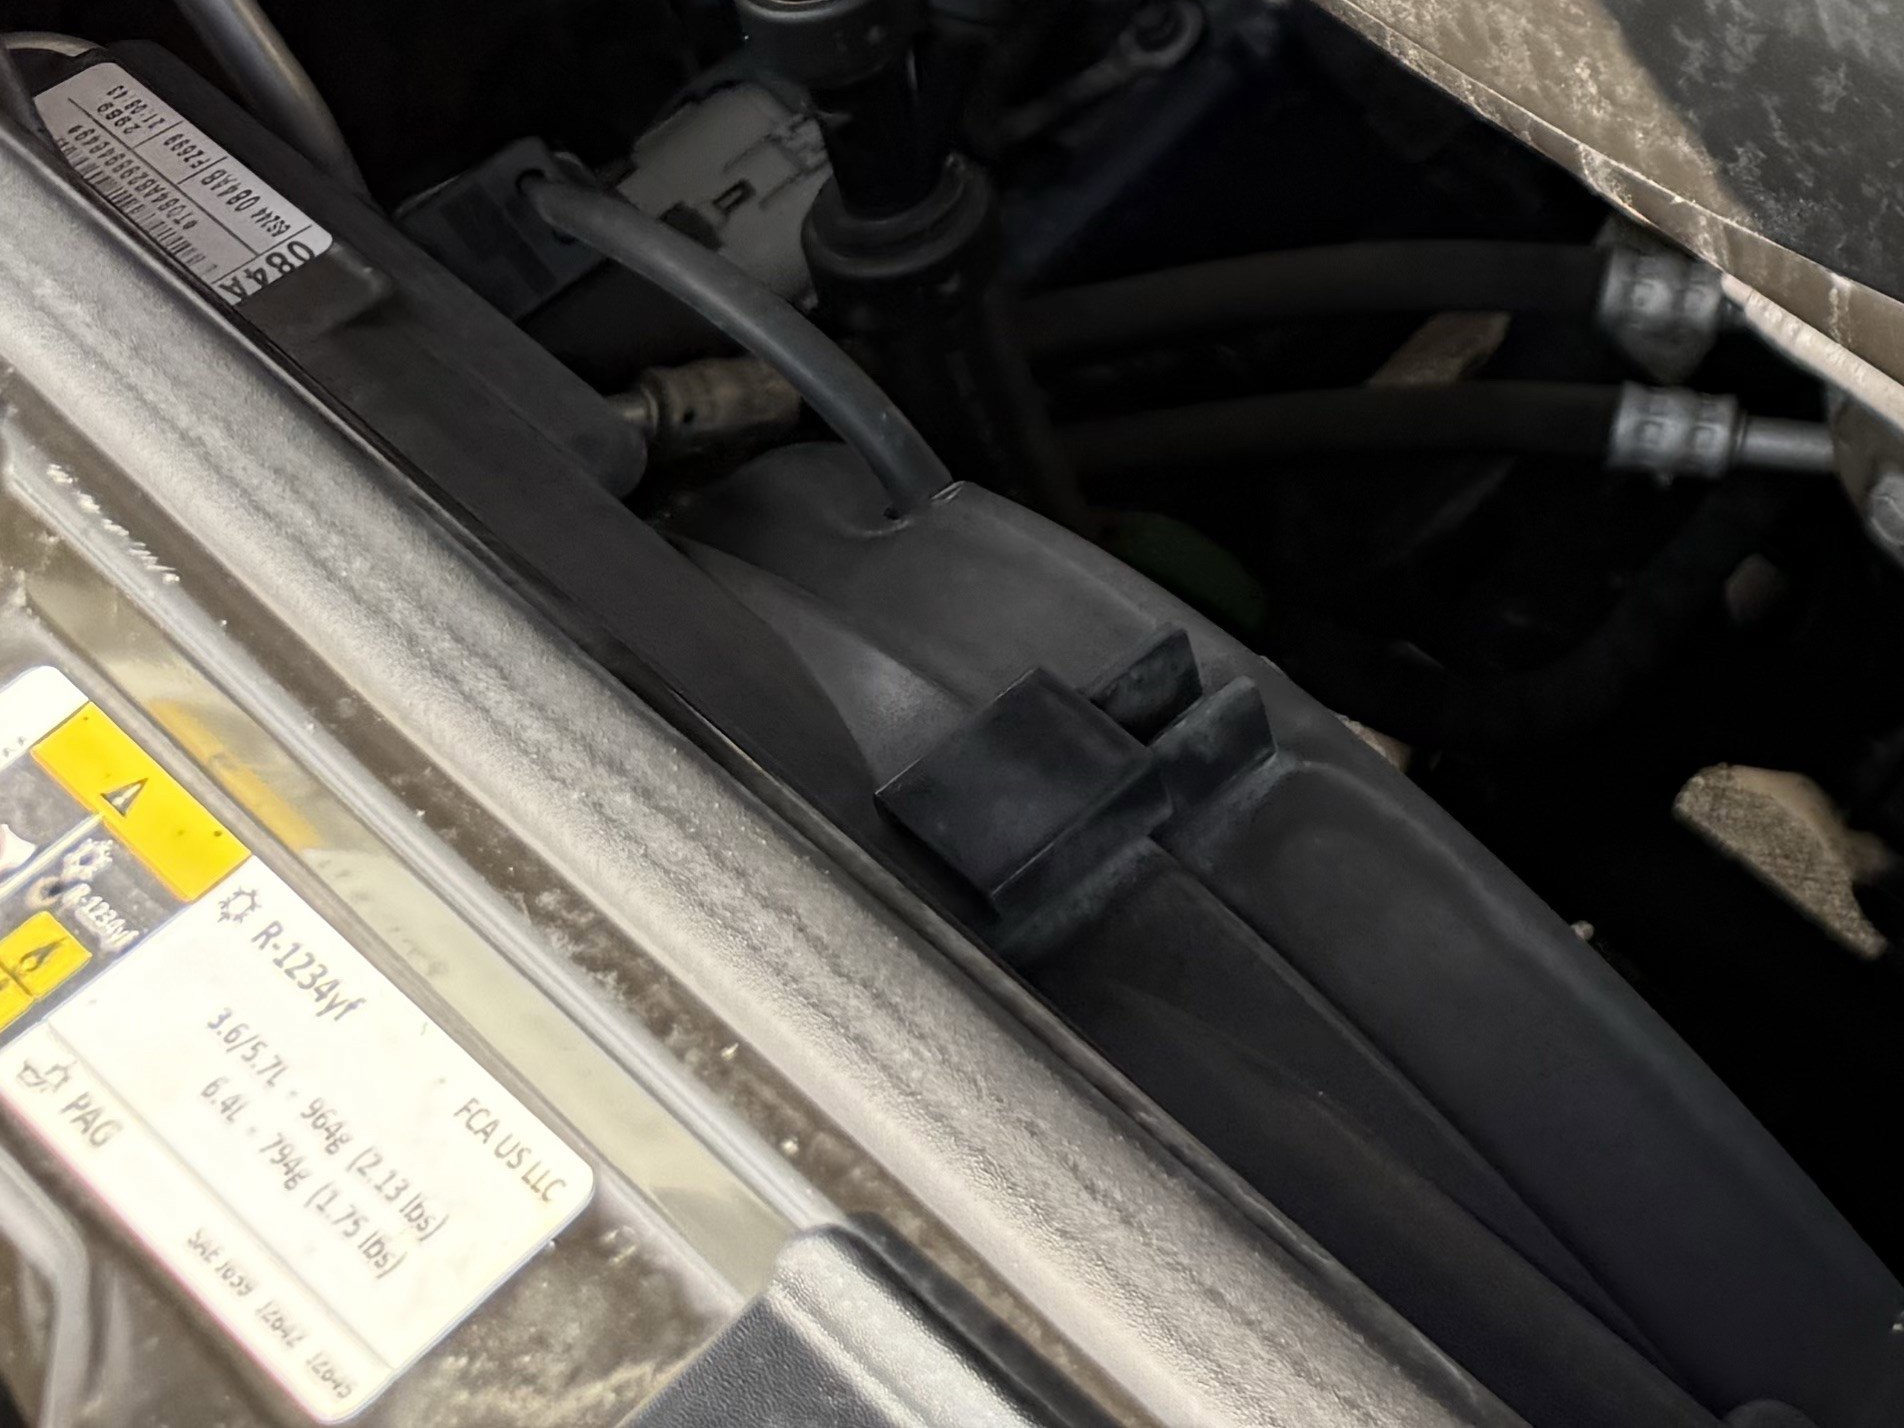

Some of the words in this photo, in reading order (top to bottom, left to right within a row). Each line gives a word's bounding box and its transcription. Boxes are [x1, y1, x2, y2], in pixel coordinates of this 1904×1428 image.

[201, 169, 260, 211] 084AB
[218, 240, 314, 301] 084A
[251, 920, 367, 1021] R-1234yf
[60, 1091, 124, 1147] PAG
[206, 1007, 289, 1088] 3.6/5.7L
[300, 1096, 352, 1156] 964g
[345, 1145, 409, 1203] (2.13
[399, 1192, 450, 1242] lbs)
[453, 1097, 501, 1145] FCA
[493, 1134, 533, 1170] US
[520, 1160, 567, 1203] LLC
[200, 1076, 250, 1124] 6.4L
[259, 1132, 313, 1192] 794g
[303, 1180, 370, 1239] (1.75
[357, 1229, 408, 1280] lbs)
[187, 1227, 221, 1264] SAE
